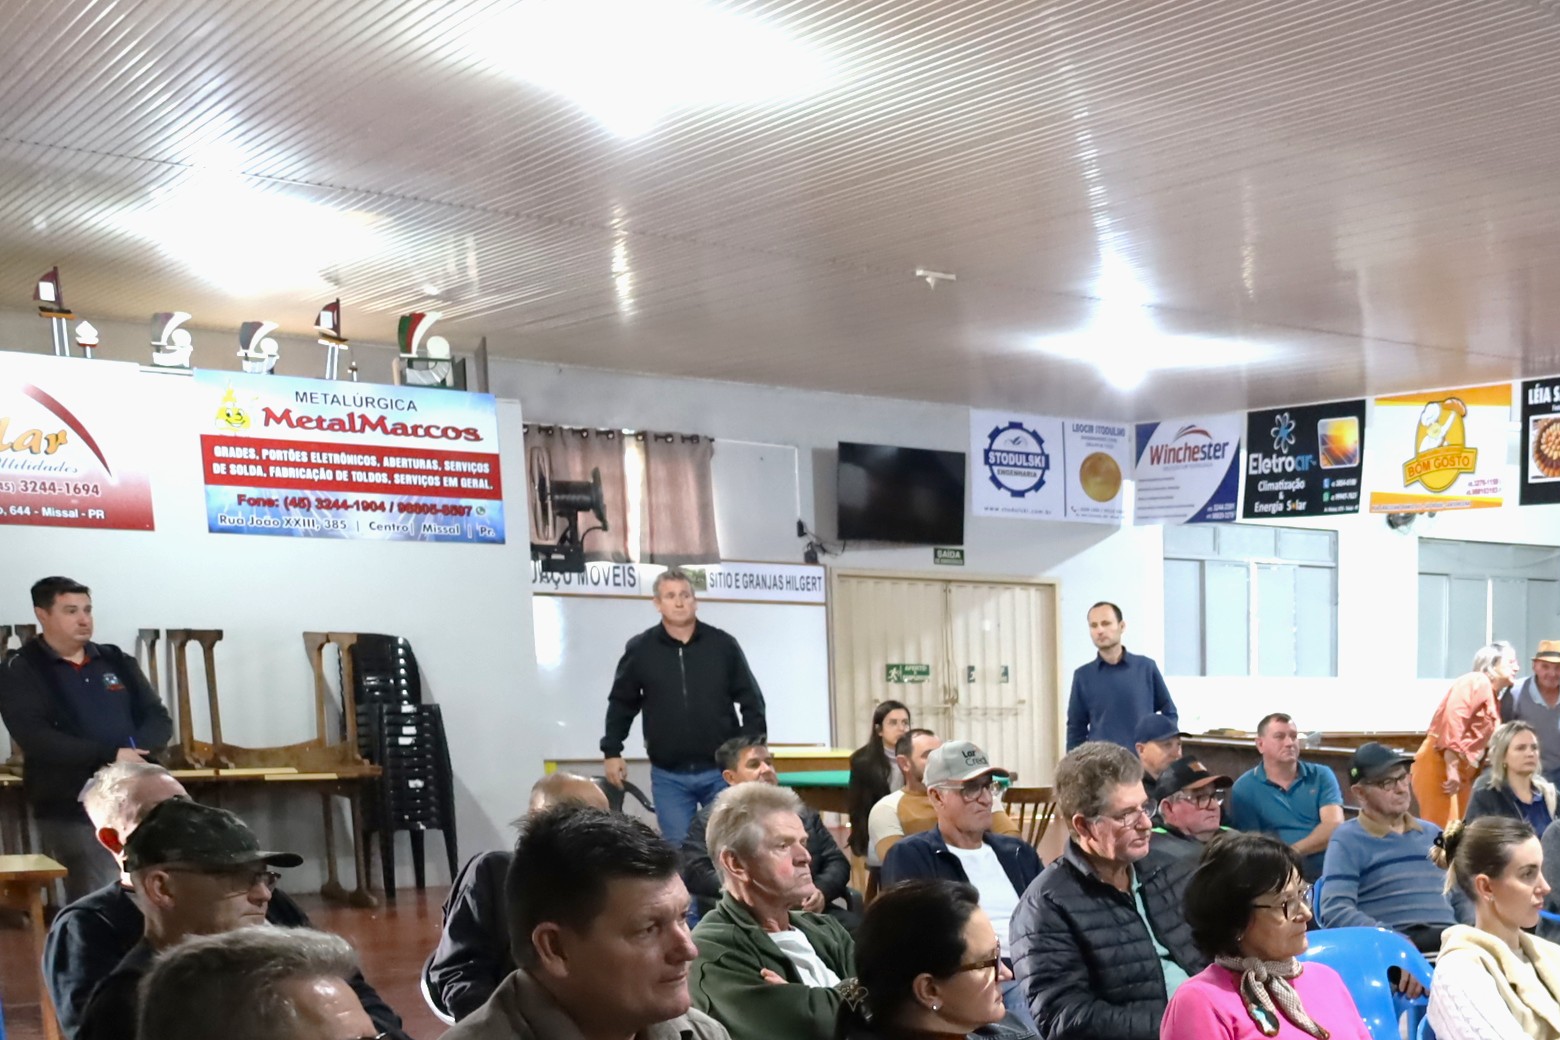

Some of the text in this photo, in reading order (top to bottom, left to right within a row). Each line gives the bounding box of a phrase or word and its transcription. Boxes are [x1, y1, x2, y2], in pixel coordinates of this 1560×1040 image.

[295, 391, 418, 412] METALÚRGICA
[1528, 383, 1552, 406] LÉIA
[262, 406, 484, 442] MetalMarcos
[262, 448, 308, 464] PORTÕES
[444, 459, 490, 476] SERVIÇOS
[988, 451, 1046, 468] STODULSKI
[1149, 441, 1230, 466] Winchester
[212, 463, 227, 475] DE
[335, 469, 349, 481] DE
[393, 473, 441, 488] SERVIÇOS
[443, 476, 458, 488] EM
[1407, 455, 1470, 478] BOM GOSTO
[19, 479, 102, 497] 3244-1694
[9, 506, 31, 516] 644
[41, 506, 79, 519] Missal
[88, 508, 105, 520] PR
[218, 514, 245, 526] Rua
[324, 519, 348, 530] 385
[368, 521, 409, 532] Centro
[421, 523, 461, 536] Missal
[735, 572, 741, 589] E
[741, 572, 785, 591] GRANJAS
[785, 573, 823, 592] HILGERT
